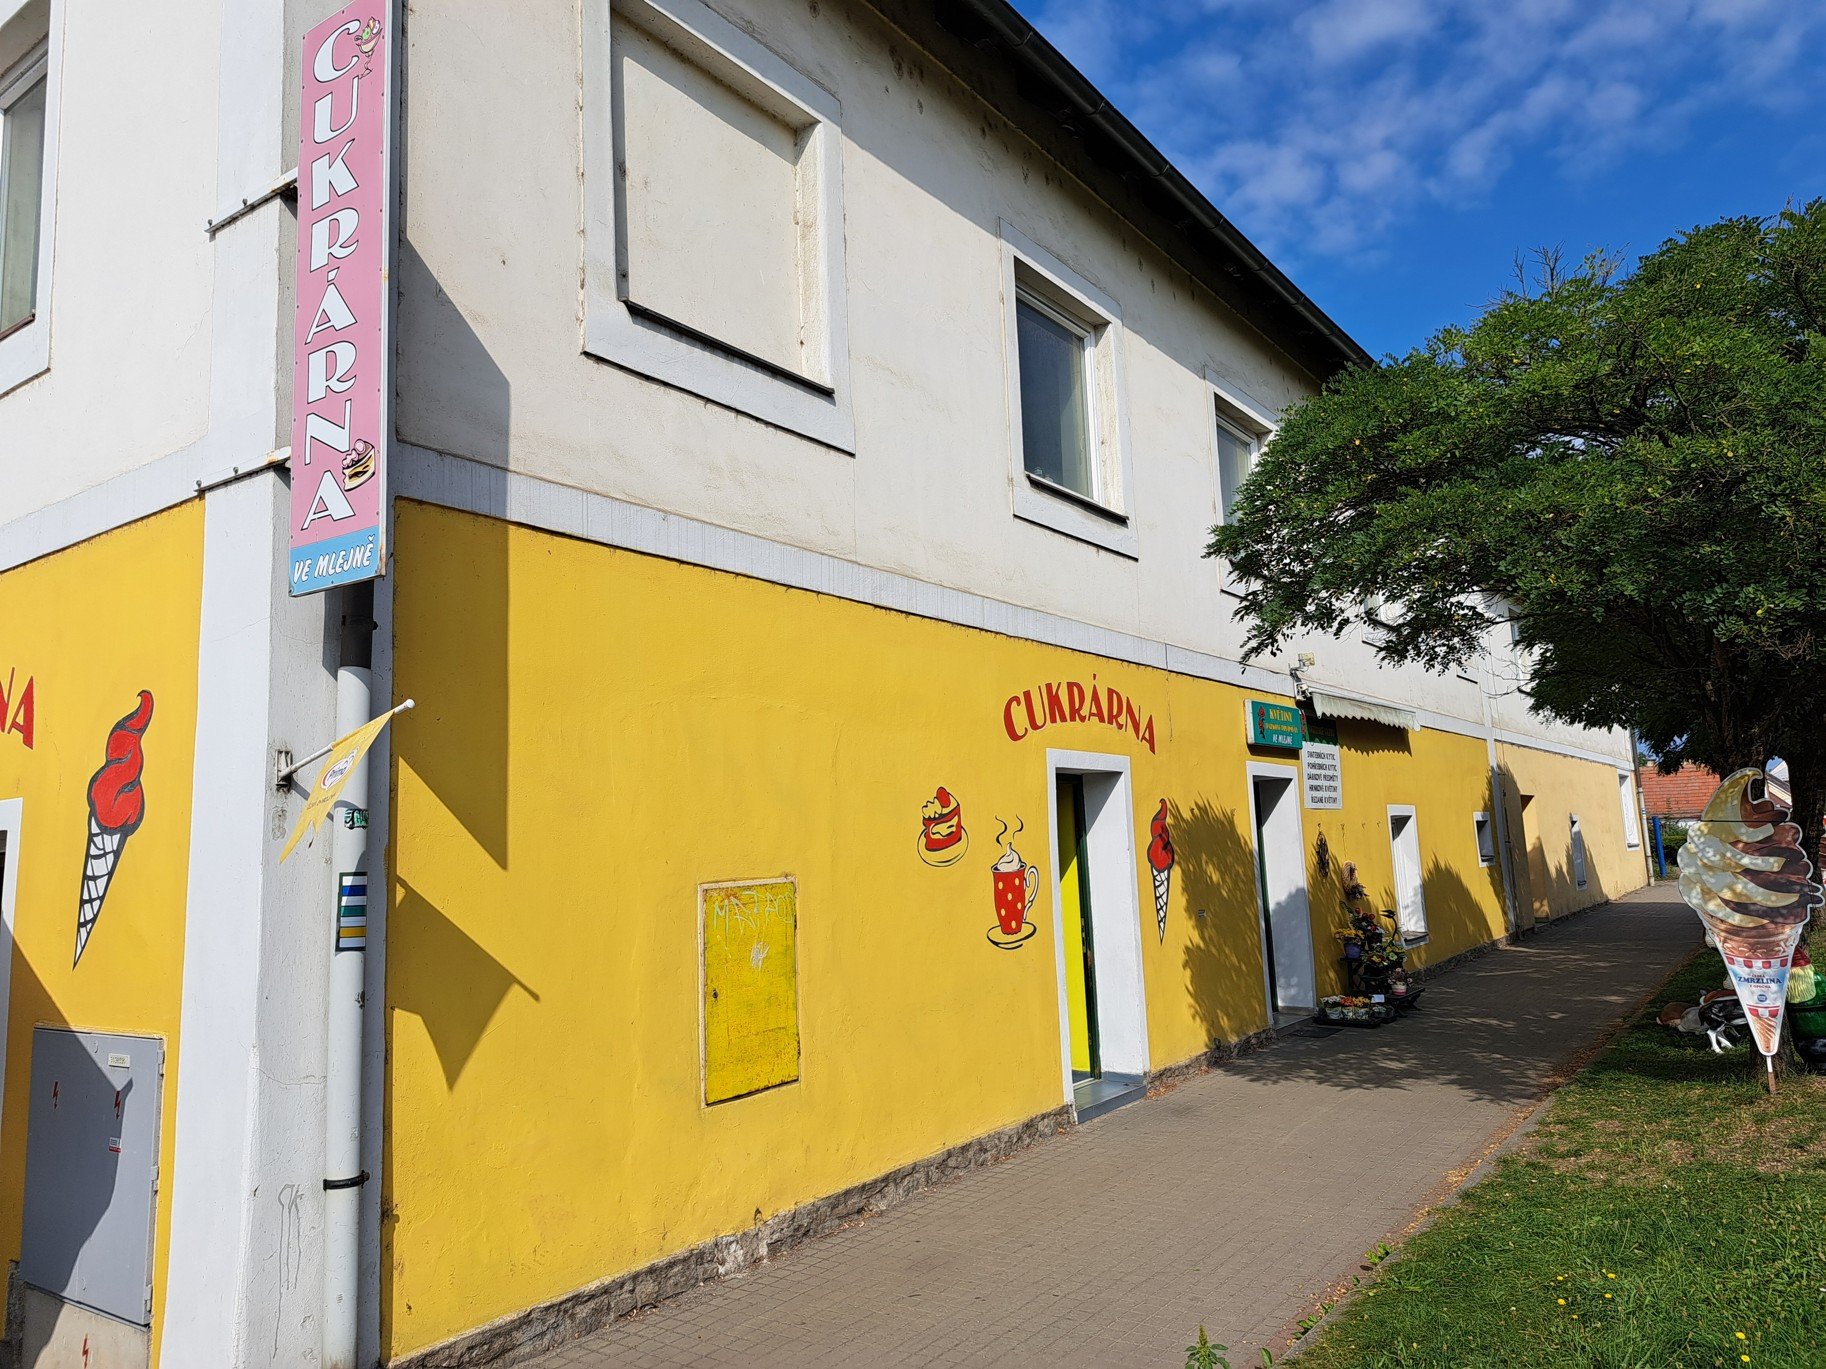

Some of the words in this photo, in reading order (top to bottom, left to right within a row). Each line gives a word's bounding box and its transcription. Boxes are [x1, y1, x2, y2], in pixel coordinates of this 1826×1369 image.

[301, 19, 361, 532] CUKRÁRNA
[293, 558, 313, 584] VE
[314, 533, 375, 579] MLEJNĚ
[1003, 673, 1156, 755] CUKRÁRNA
[1269, 707, 1293, 721] KVĚTINY
[1738, 976, 1782, 984] ZMRZLINA
